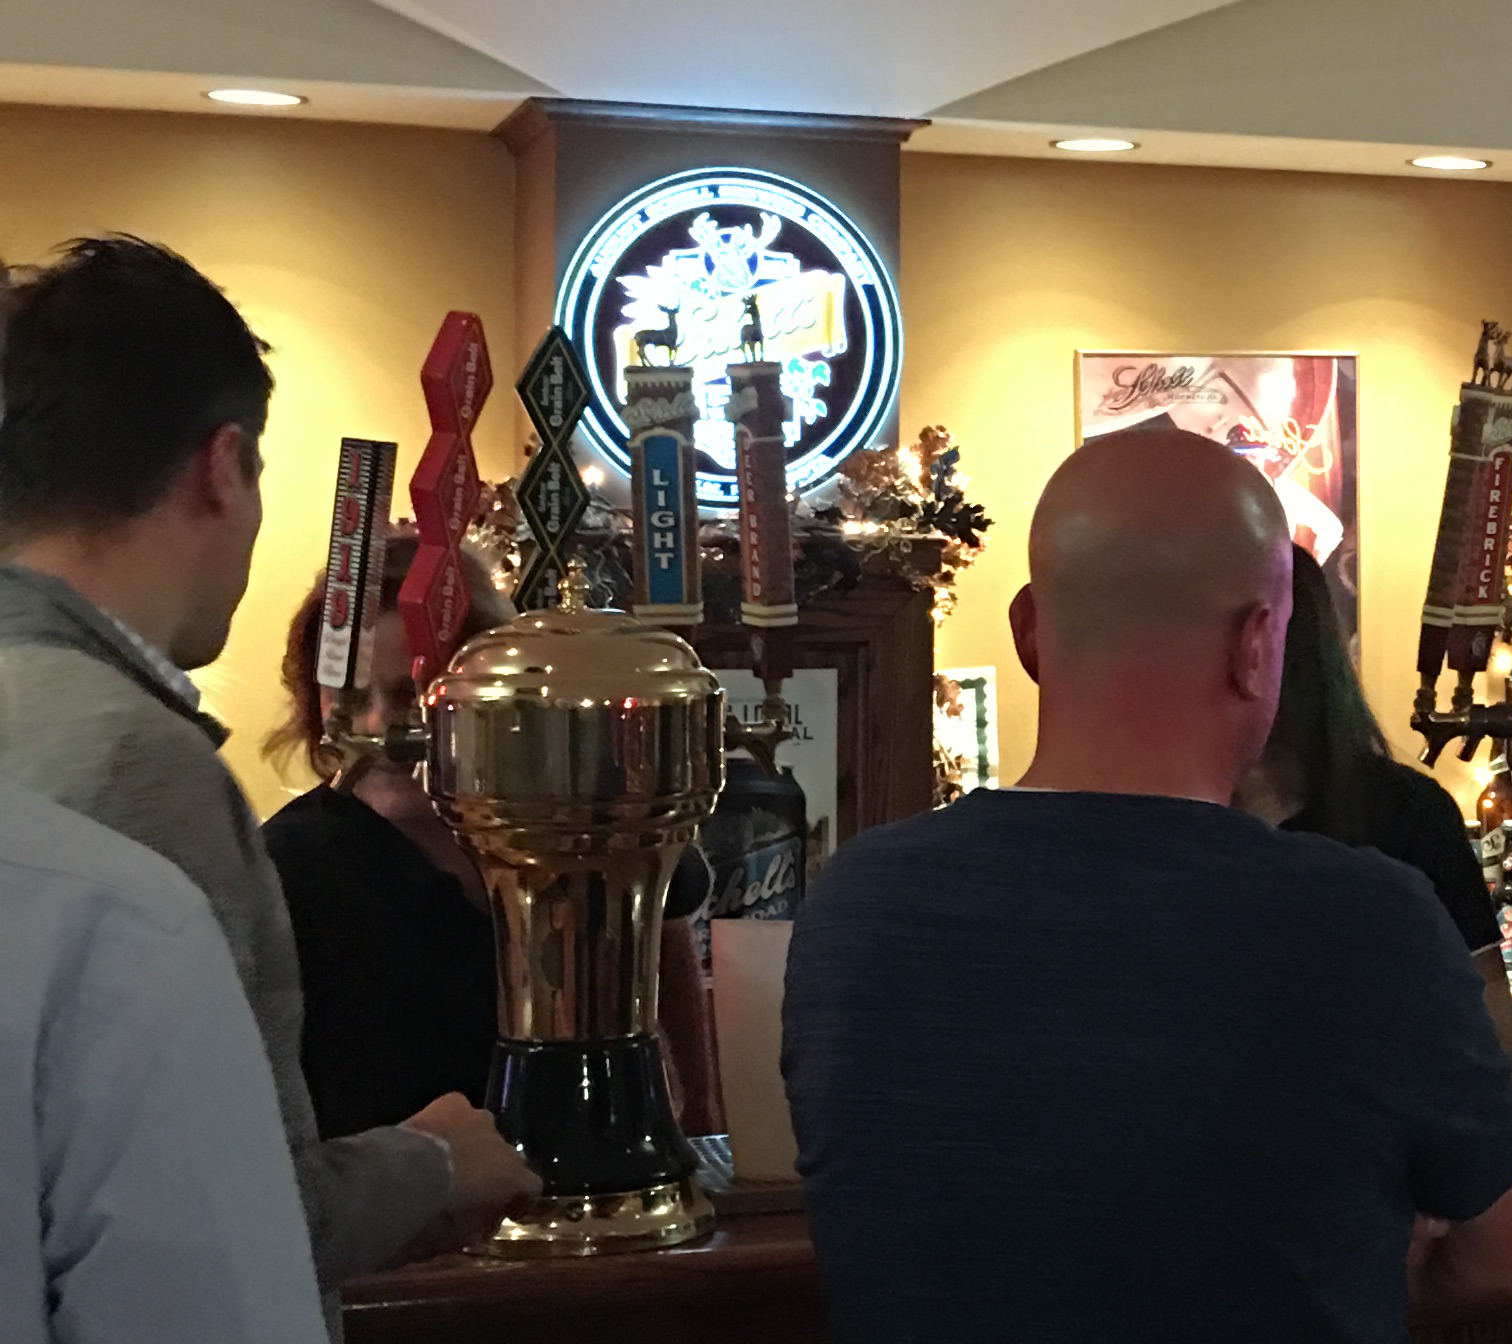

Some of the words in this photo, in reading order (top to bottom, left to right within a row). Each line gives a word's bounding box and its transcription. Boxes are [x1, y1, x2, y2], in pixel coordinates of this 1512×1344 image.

[465, 342, 479, 373] Belt
[550, 356, 563, 385] Belt
[460, 375, 475, 419] Grain
[549, 387, 563, 428] Grain
[454, 454, 467, 485] Belt
[547, 461, 561, 491] Belt
[449, 487, 464, 532] Grain
[546, 492, 560, 533] Grain
[650, 468, 676, 570] LIGHT
[1477, 457, 1505, 599] FIREBRICK
[329, 446, 362, 633] 1919
[443, 565, 458, 595] Belt
[438, 598, 452, 642] Grain
